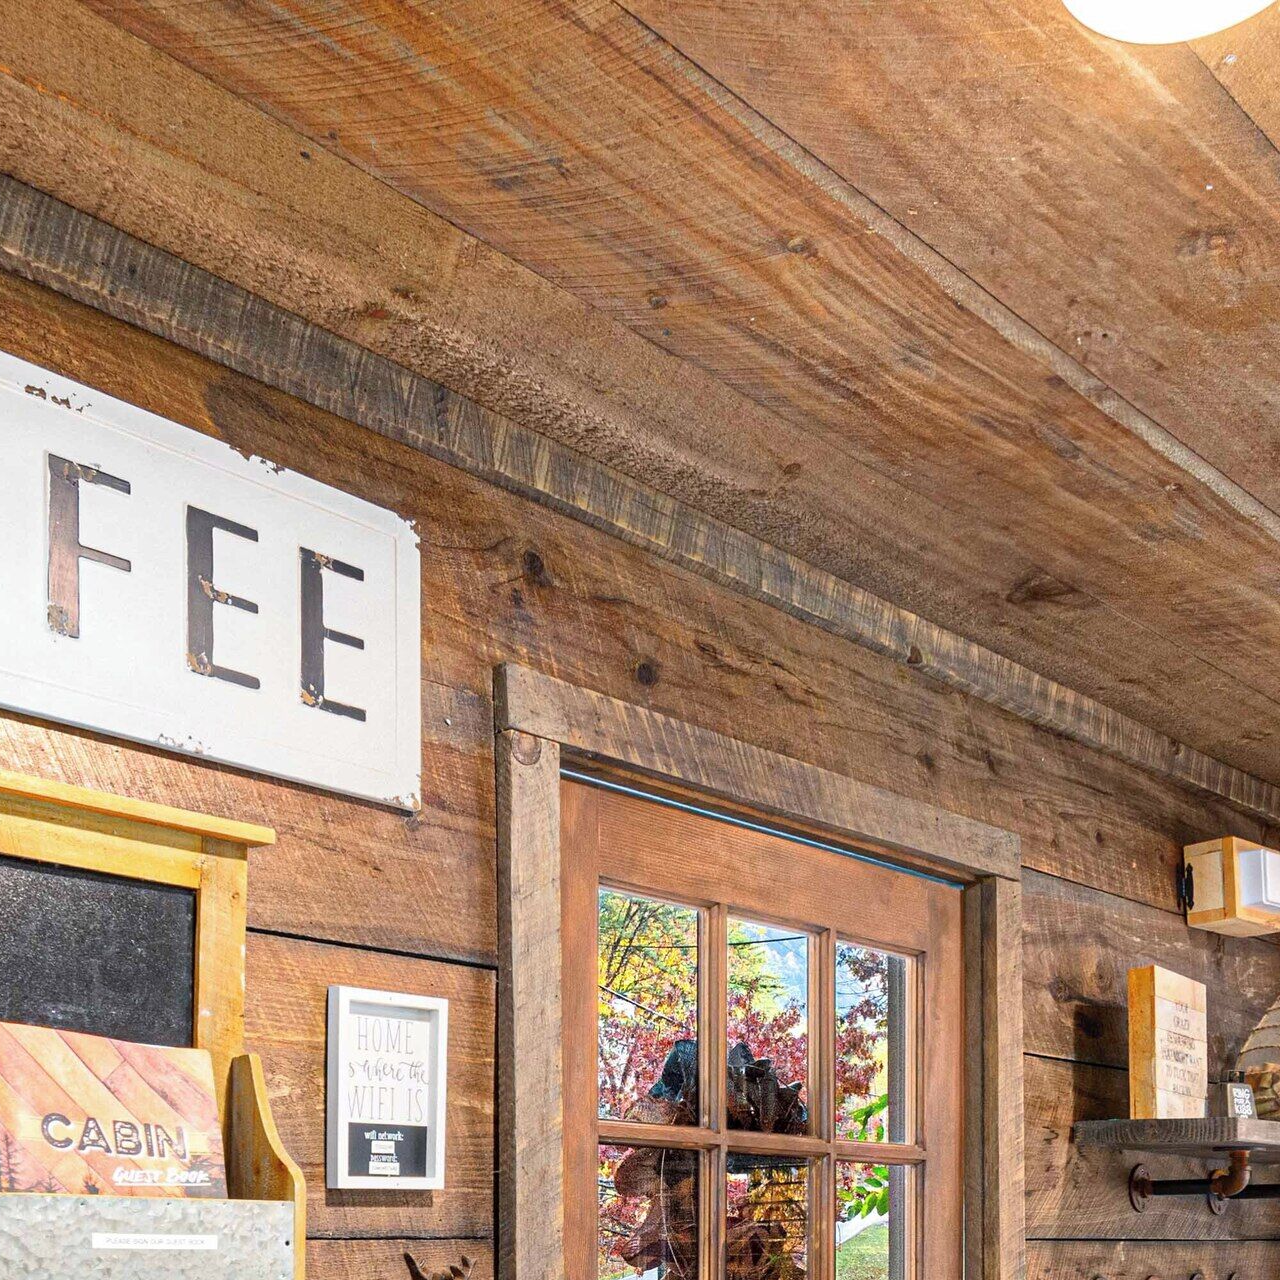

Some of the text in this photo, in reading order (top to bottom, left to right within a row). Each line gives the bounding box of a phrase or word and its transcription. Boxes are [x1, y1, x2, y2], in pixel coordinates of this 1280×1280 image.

[357, 1016, 414, 1054] HOME
[348, 1086, 423, 1122] WIFI IS
[41, 1112, 187, 1160] CABIN
